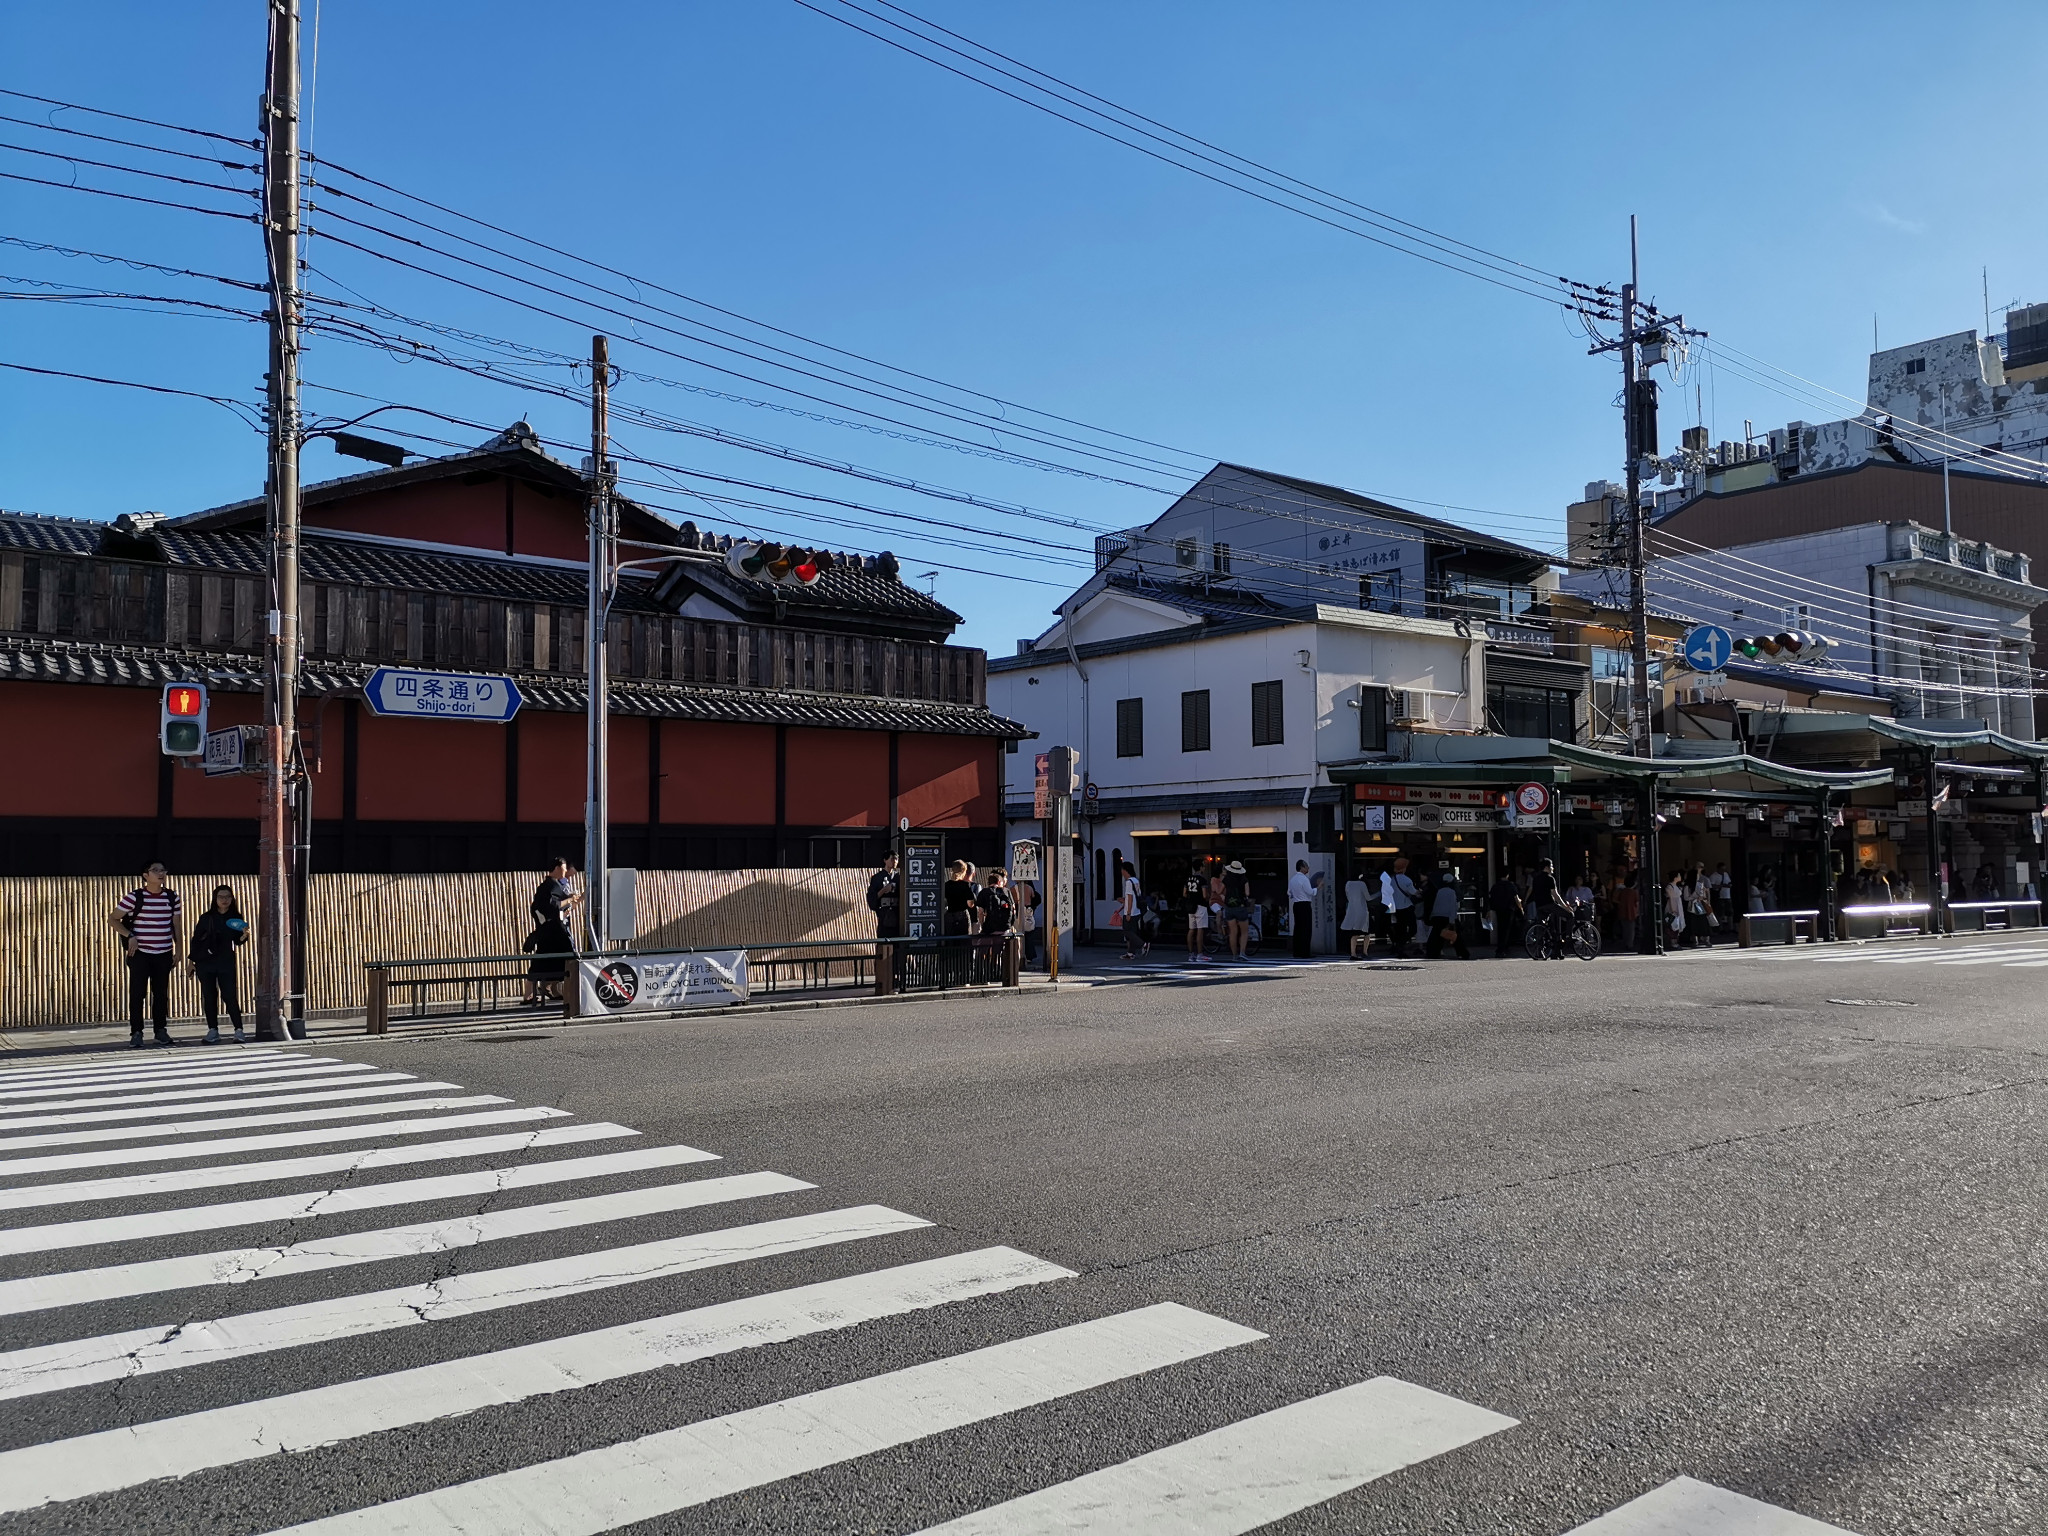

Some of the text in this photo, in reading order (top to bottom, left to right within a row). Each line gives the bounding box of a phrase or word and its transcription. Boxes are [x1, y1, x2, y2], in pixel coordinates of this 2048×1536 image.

[395, 677, 493, 701] 四条通り
[416, 698, 475, 713] Shijo-dori
[209, 734, 235, 758] 花見小路
[1391, 808, 1415, 820] SHOP
[1444, 811, 1472, 822] COFFEE
[645, 976, 734, 991] NO BICYCLE RIDING
